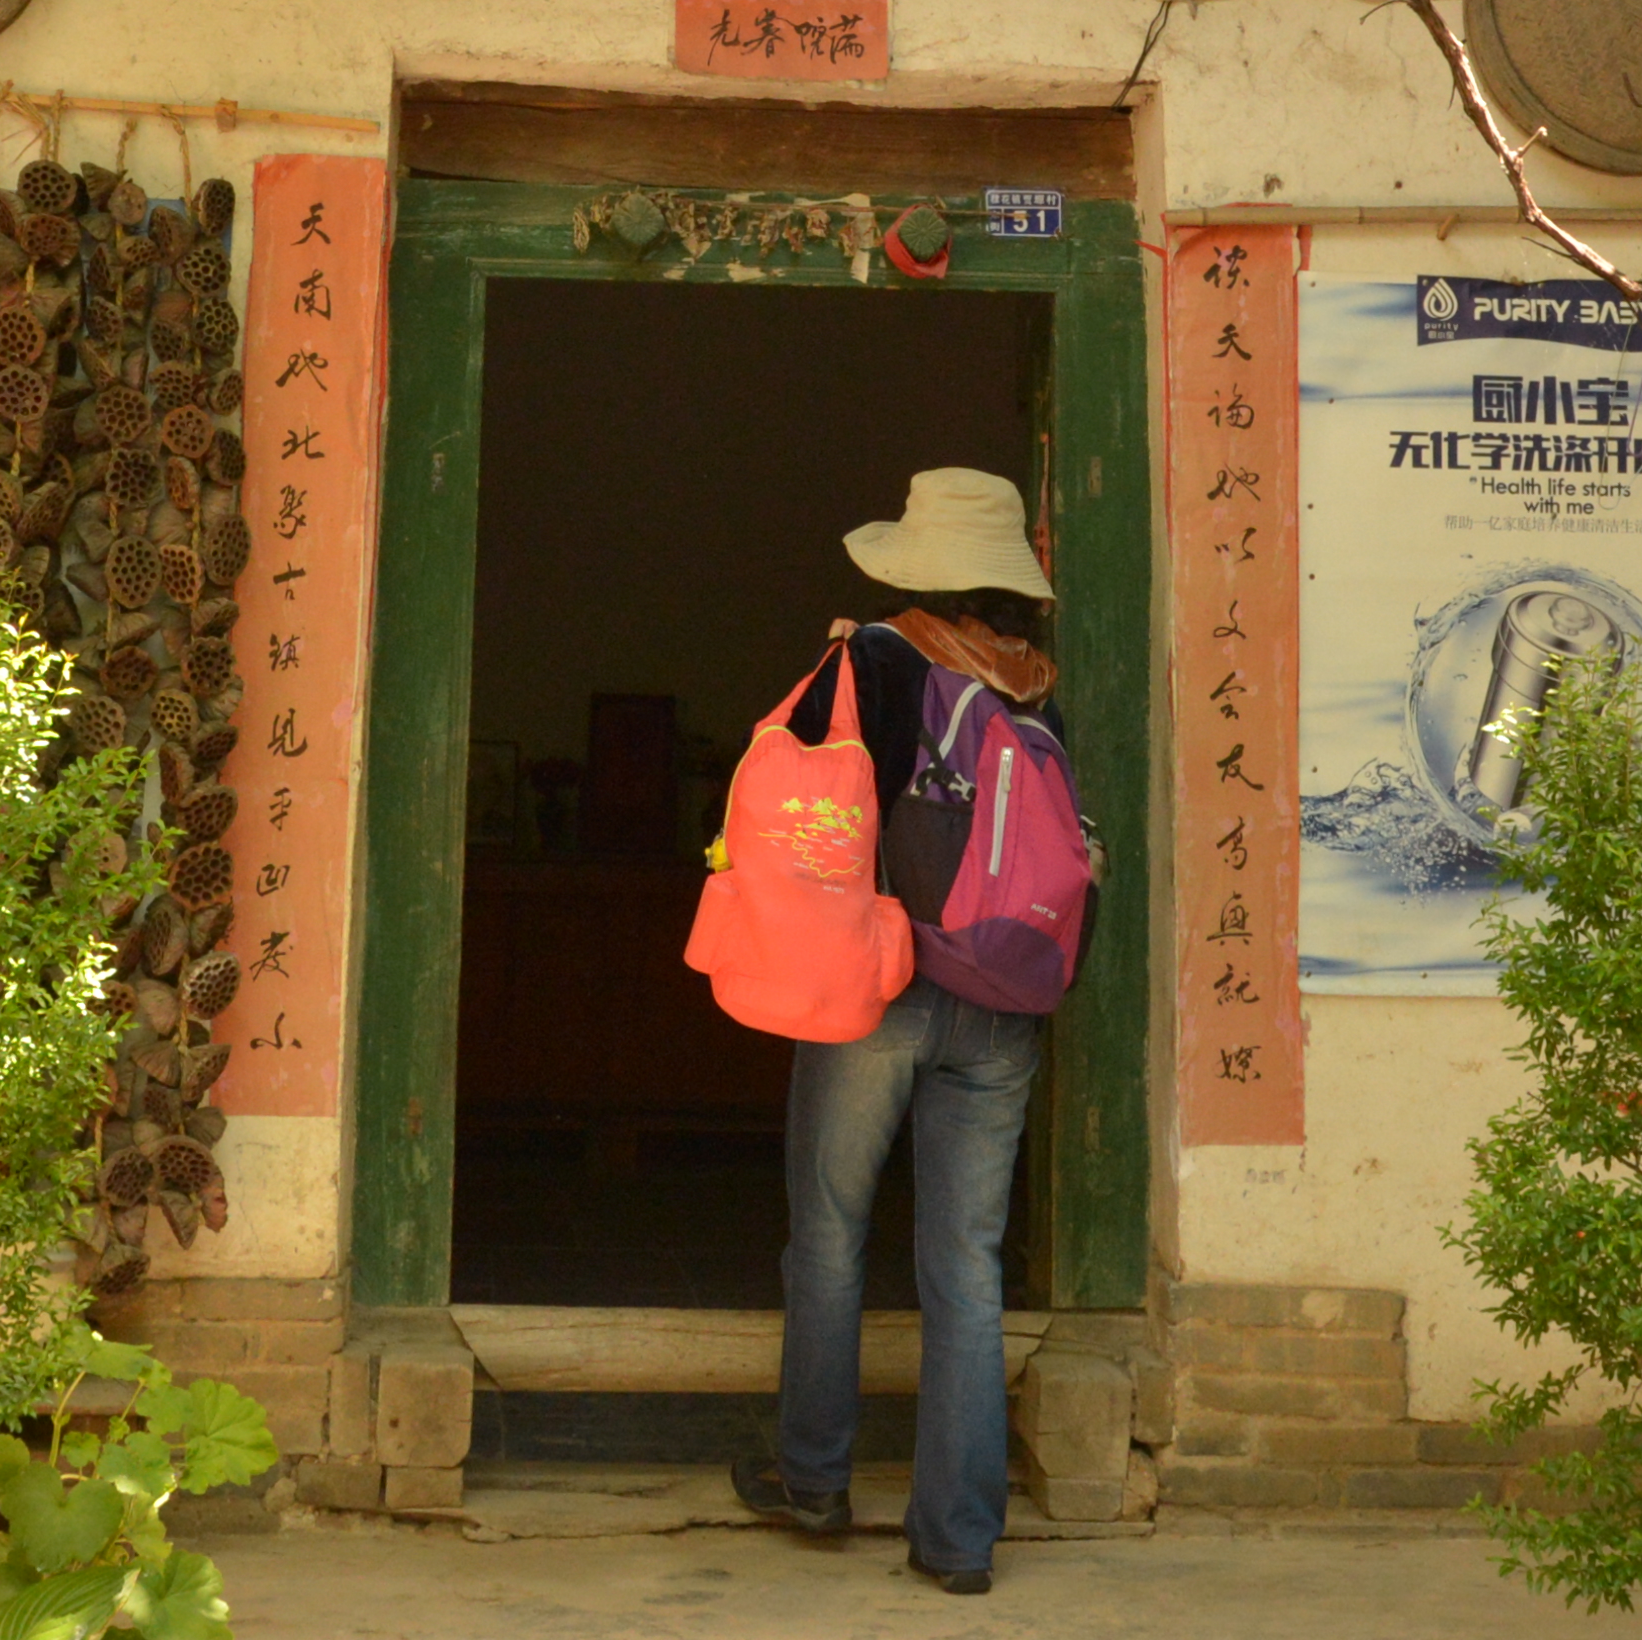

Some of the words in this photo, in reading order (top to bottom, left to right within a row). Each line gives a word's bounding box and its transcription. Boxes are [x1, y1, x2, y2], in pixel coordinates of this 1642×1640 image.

[1012, 210, 1046, 233] 51
[1473, 297, 1570, 324] PURITY
[1472, 375, 1629, 426] 厨小宝
[1547, 478, 1576, 497] life
[1582, 482, 1632, 498] starts
[1523, 496, 1560, 514] with
[1566, 501, 1595, 515] me
